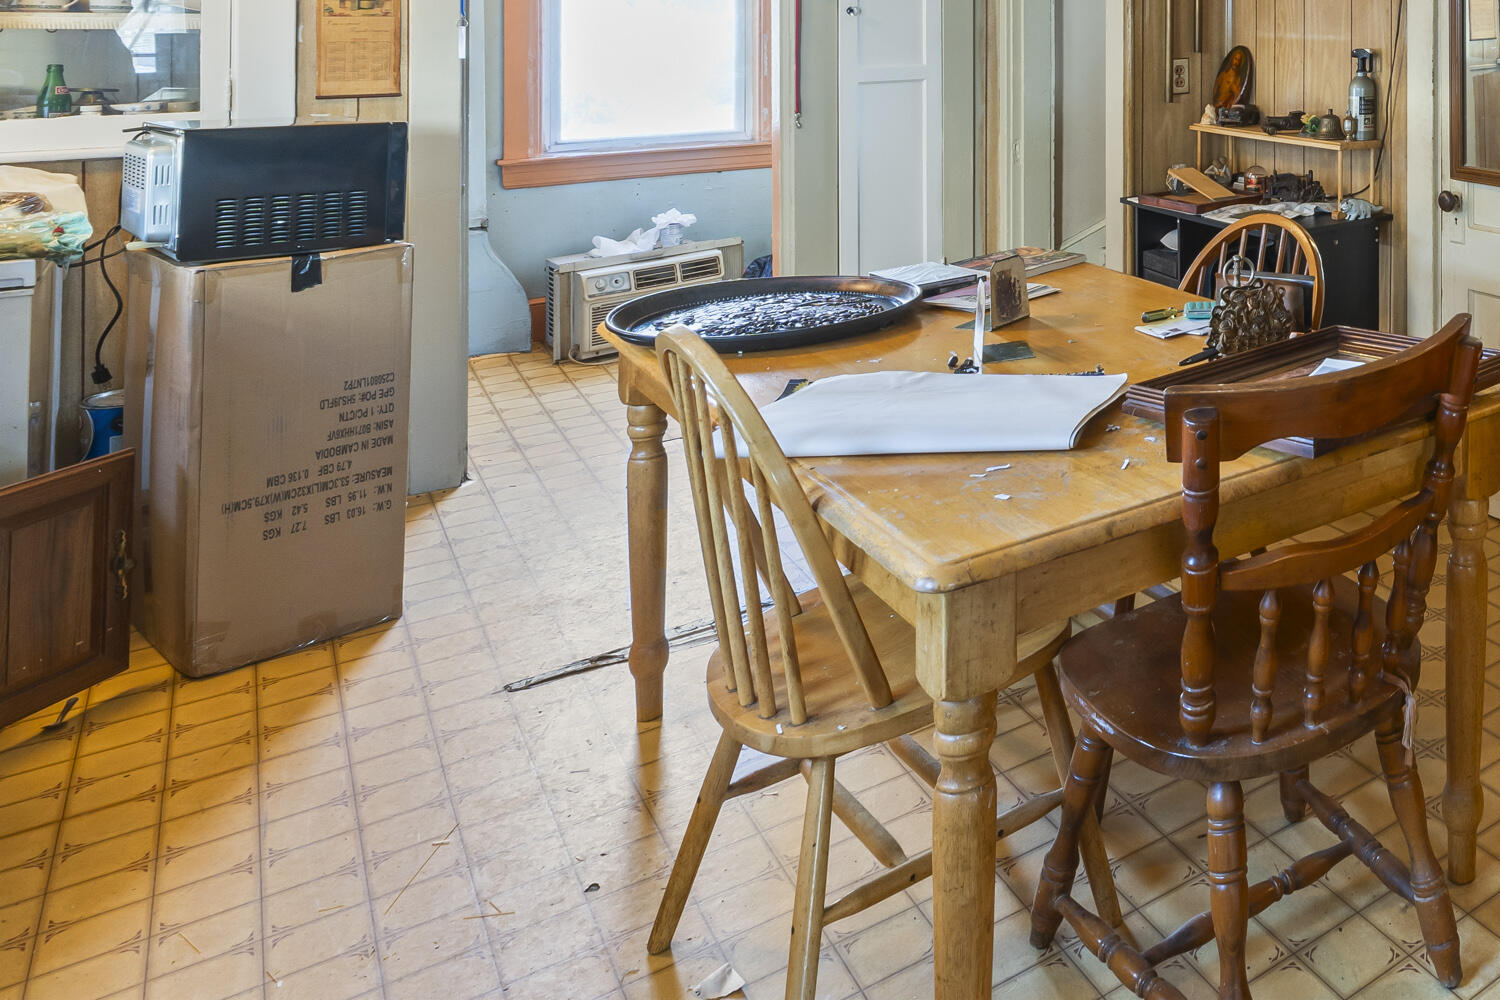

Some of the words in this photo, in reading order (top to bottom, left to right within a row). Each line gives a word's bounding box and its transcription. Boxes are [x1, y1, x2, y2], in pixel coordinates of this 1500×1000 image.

[378, 387, 395, 399] GPE
[371, 407, 374, 416] 1
[376, 402, 394, 415] QTY:
[374, 419, 394, 431] ASIN:
[361, 440, 369, 452] IN
[371, 434, 394, 449] MADE
[315, 441, 359, 460] CAMBODIA
[318, 463, 335, 476] CBF
[336, 460, 352, 472] 4.79
[266, 474, 286, 488] CBM
[352, 466, 393, 484] MEASURE:
[325, 494, 342, 508] LBS
[264, 508, 283, 522] KGS
[291, 503, 308, 516] 5.42
[346, 506, 366, 519] 16.03
[324, 511, 341, 525] LBS
[263, 527, 282, 540] KGS
[291, 521, 307, 534] 7.27
